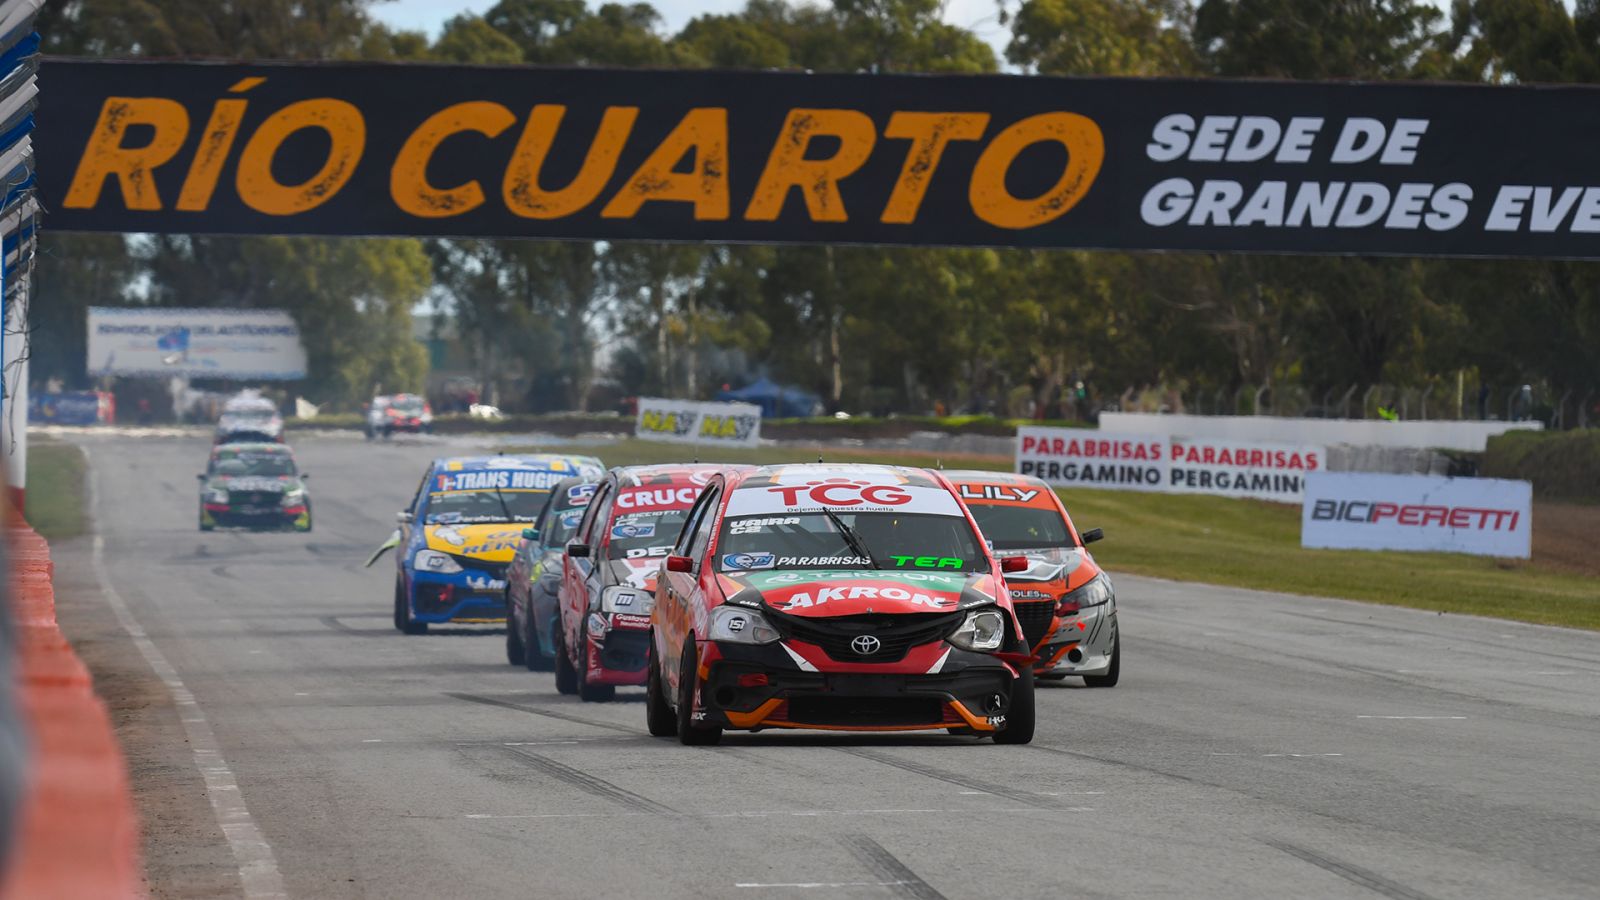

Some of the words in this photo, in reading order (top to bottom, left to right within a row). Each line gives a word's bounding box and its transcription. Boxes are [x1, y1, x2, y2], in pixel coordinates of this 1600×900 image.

[1146, 113, 1325, 163] SEDE
[1330, 117, 1430, 165] DE
[62, 76, 366, 216] RÍO
[389, 100, 1106, 230] CUARTO
[1140, 177, 1475, 232] GRANDES
[1022, 436, 1161, 460] PARABRISAS
[1171, 444, 1319, 471] PARABRISAS
[455, 472, 509, 490] TRANS
[1020, 460, 1161, 485] PERGAMINO
[768, 483, 913, 507] TCG
[958, 484, 1038, 502] LILY
[1311, 499, 1520, 532] BICIPERETTI
[730, 527, 762, 536] C2
[777, 556, 871, 567] PARABRISAS
[890, 555, 964, 569] TEA
[807, 571, 951, 583] TEKRON
[783, 586, 946, 611] AKRON
